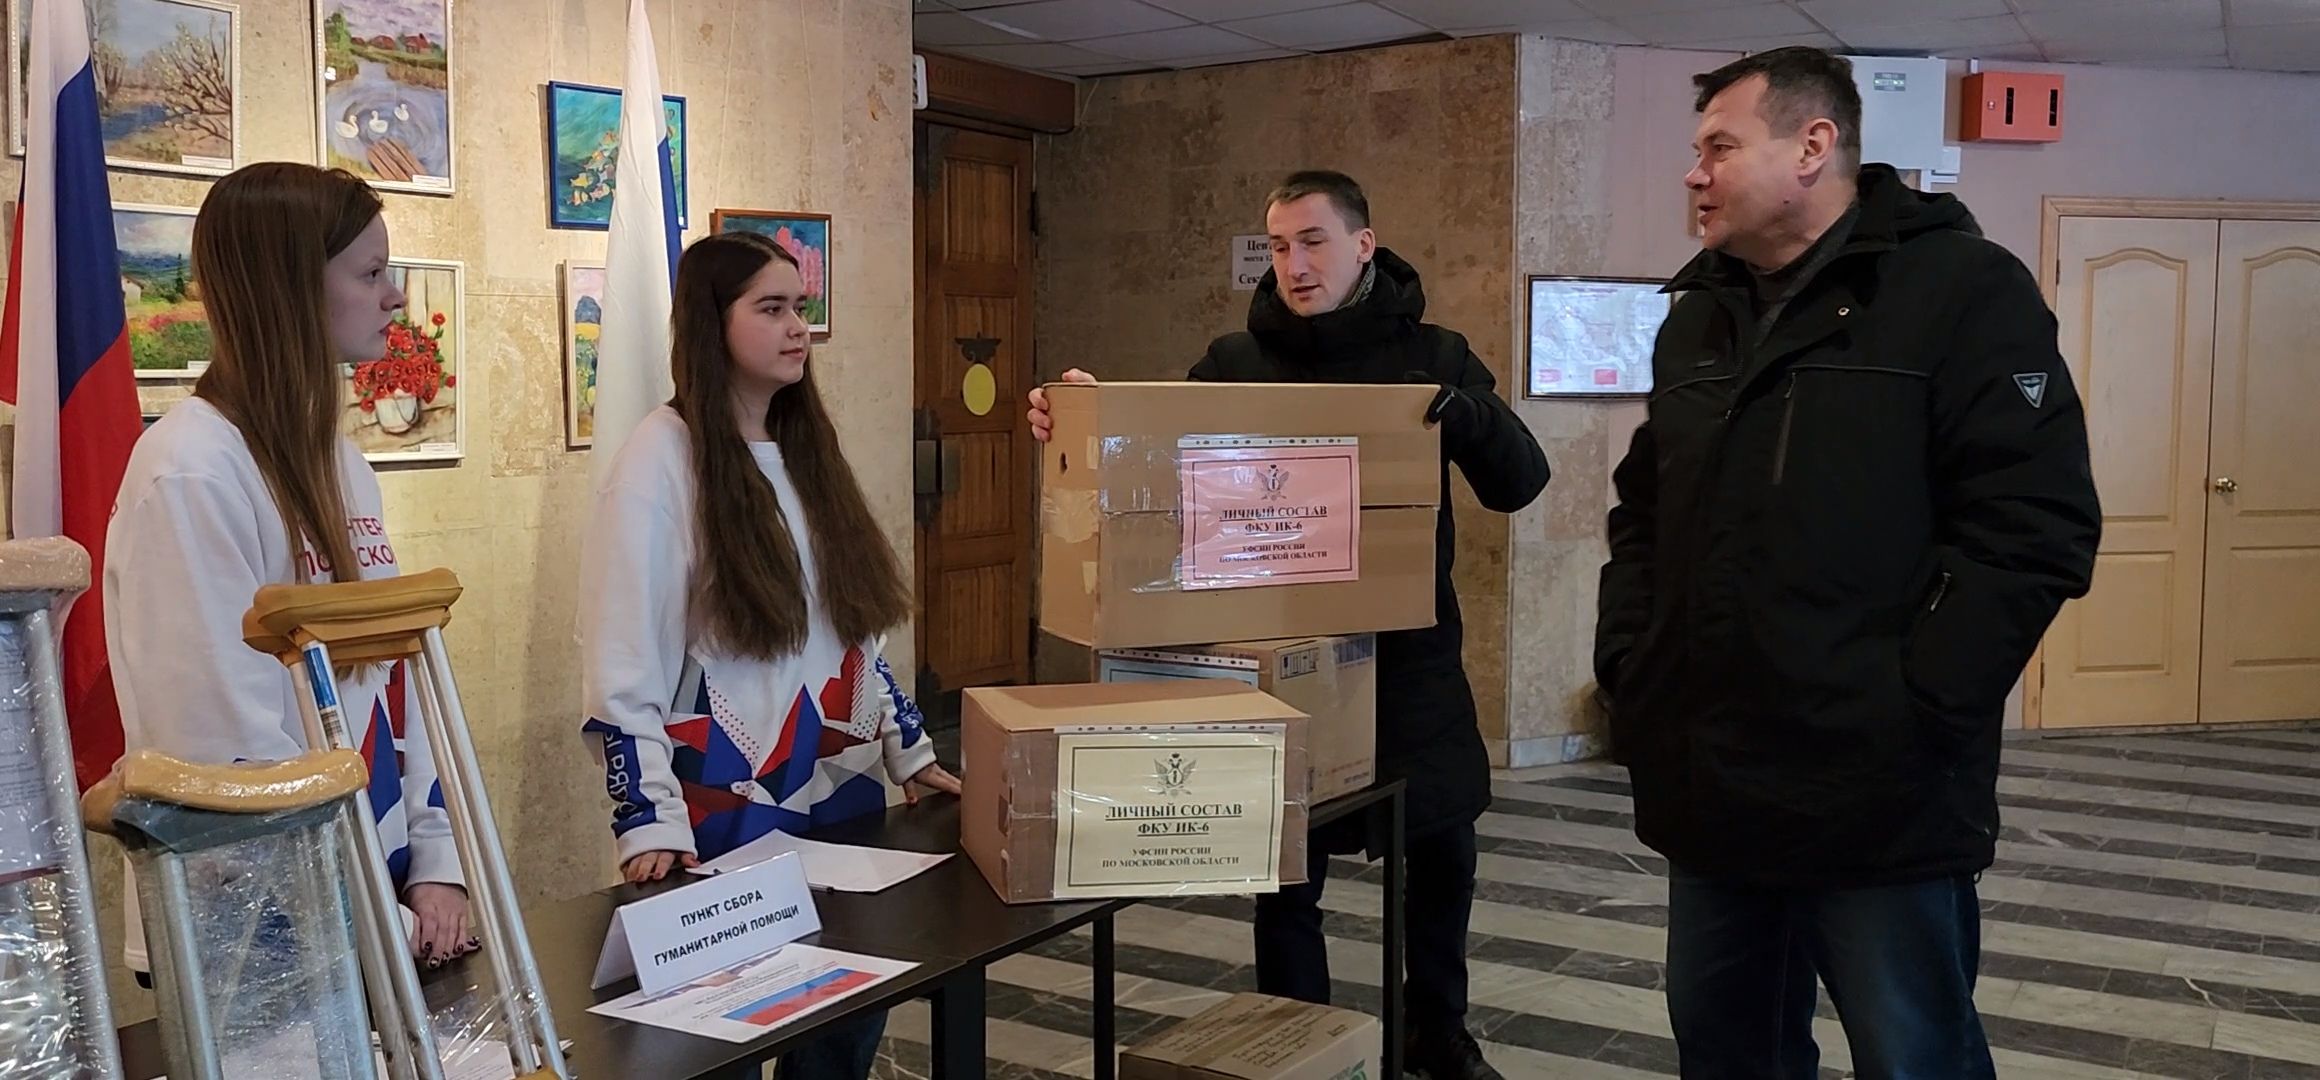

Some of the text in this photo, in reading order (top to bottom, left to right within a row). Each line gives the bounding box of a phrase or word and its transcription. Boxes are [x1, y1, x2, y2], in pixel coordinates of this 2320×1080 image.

[1239, 274, 1260, 284] Сек
[1219, 505, 1327, 519] ЛИЧНЫЙ СОСТАВ
[346, 517, 383, 537] НТЕР
[1245, 521, 1303, 532] ФКУ ИК-6
[1242, 543, 1305, 553] УФСИН РОССИИ
[1290, 551, 1327, 560] ОБЛАСТИ
[1105, 802, 1242, 818] ЛИЧНЫЙ СОСТАВ
[1138, 822, 1210, 834] ФКУ ИК-6
[1132, 847, 1211, 856] УФСИН РОССИИ
[1102, 856, 1239, 868] ПО МОСКОВСКОЙ ОБЛАСТИ
[680, 889, 763, 927] ПУНКТ СБОРА
[654, 904, 800, 966] ГУМАНИТАРНОЙ ПОМОЩИ
